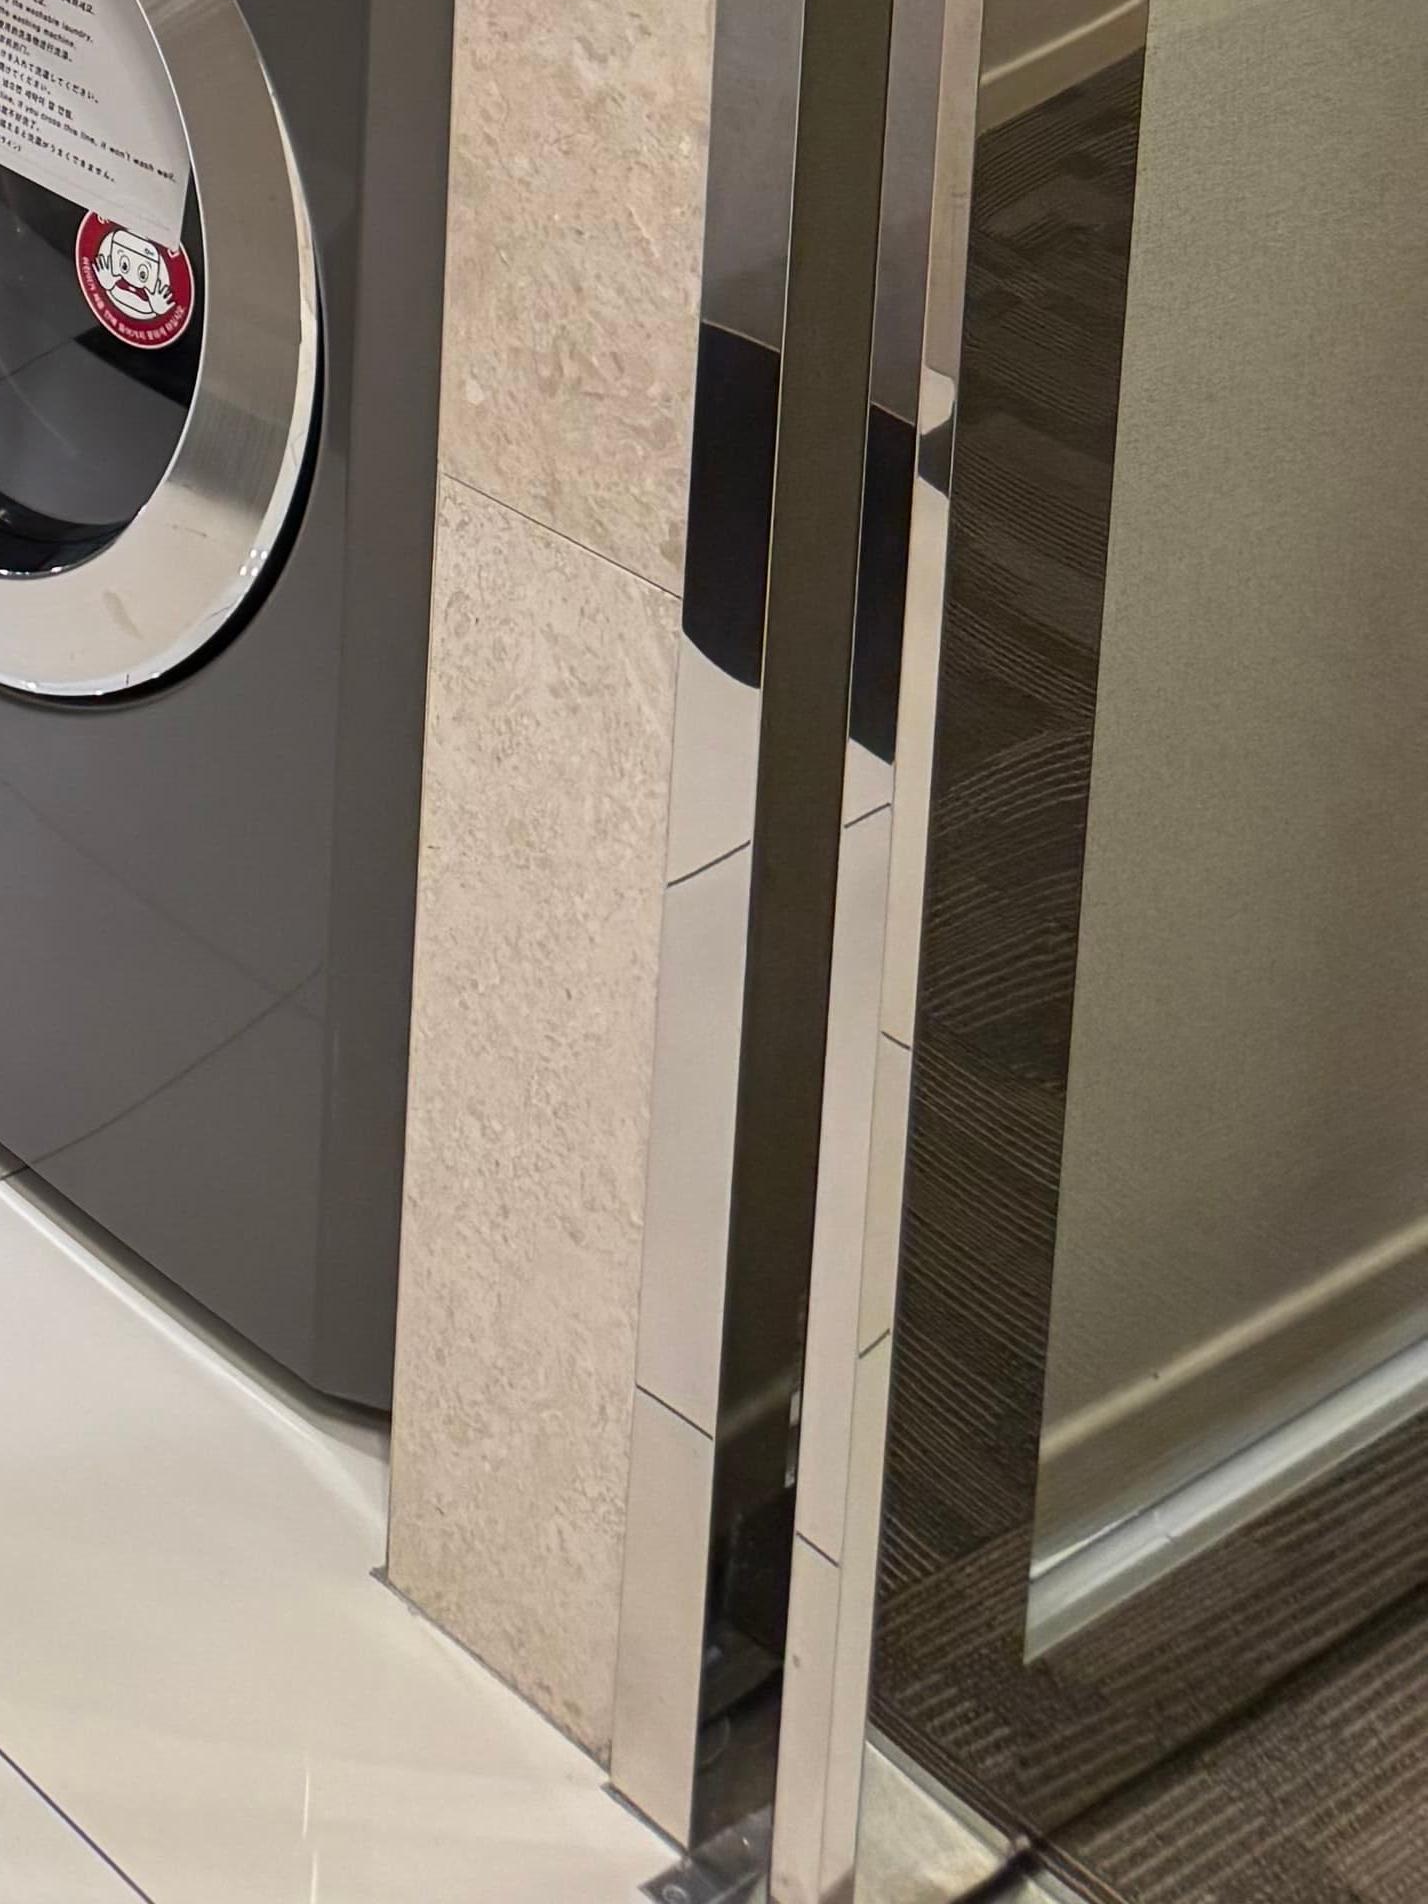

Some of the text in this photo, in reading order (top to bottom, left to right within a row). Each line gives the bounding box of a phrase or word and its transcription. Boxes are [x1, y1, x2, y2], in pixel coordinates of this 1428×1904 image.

[12, 10, 41, 34] washing
[43, 24, 76, 50] machine.
[24, 2, 60, 28] washable
[24, 103, 38, 118] you
[40, 110, 61, 128] cross
[63, 120, 77, 136] this
[100, 139, 106, 150] it
[109, 142, 129, 162] won't
[132, 154, 154, 173] wash
